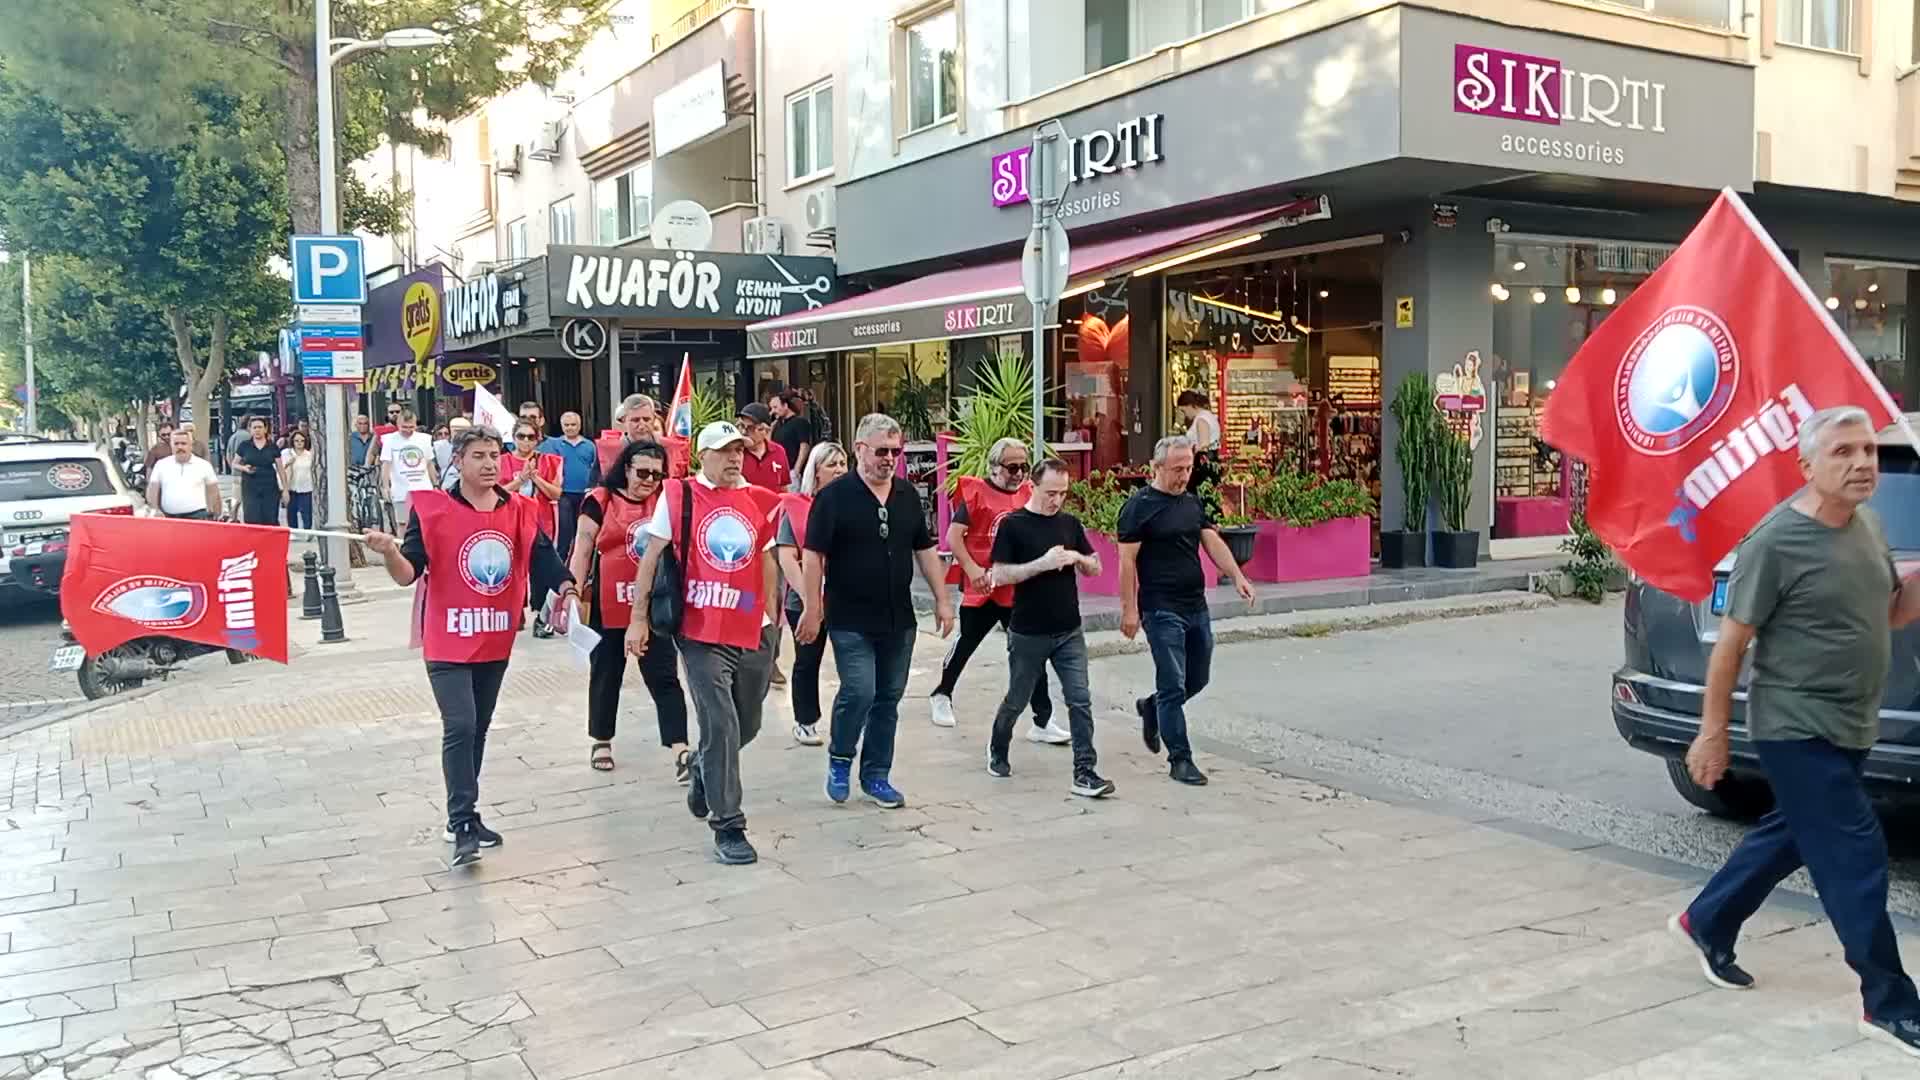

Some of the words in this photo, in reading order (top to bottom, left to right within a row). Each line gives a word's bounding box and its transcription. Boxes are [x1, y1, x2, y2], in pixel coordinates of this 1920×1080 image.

[1501, 133, 1624, 164] accessories
[310, 245, 349, 295] P
[566, 251, 721, 313] KUAFÖR
[735, 279, 782, 297] KENAN
[406, 289, 430, 338] gratis
[735, 299, 781, 316] AYDIN
[574, 323, 595, 347] K
[853, 320, 901, 337] accessories
[449, 366, 491, 382] gratis
[447, 608, 509, 637] Eğitim
